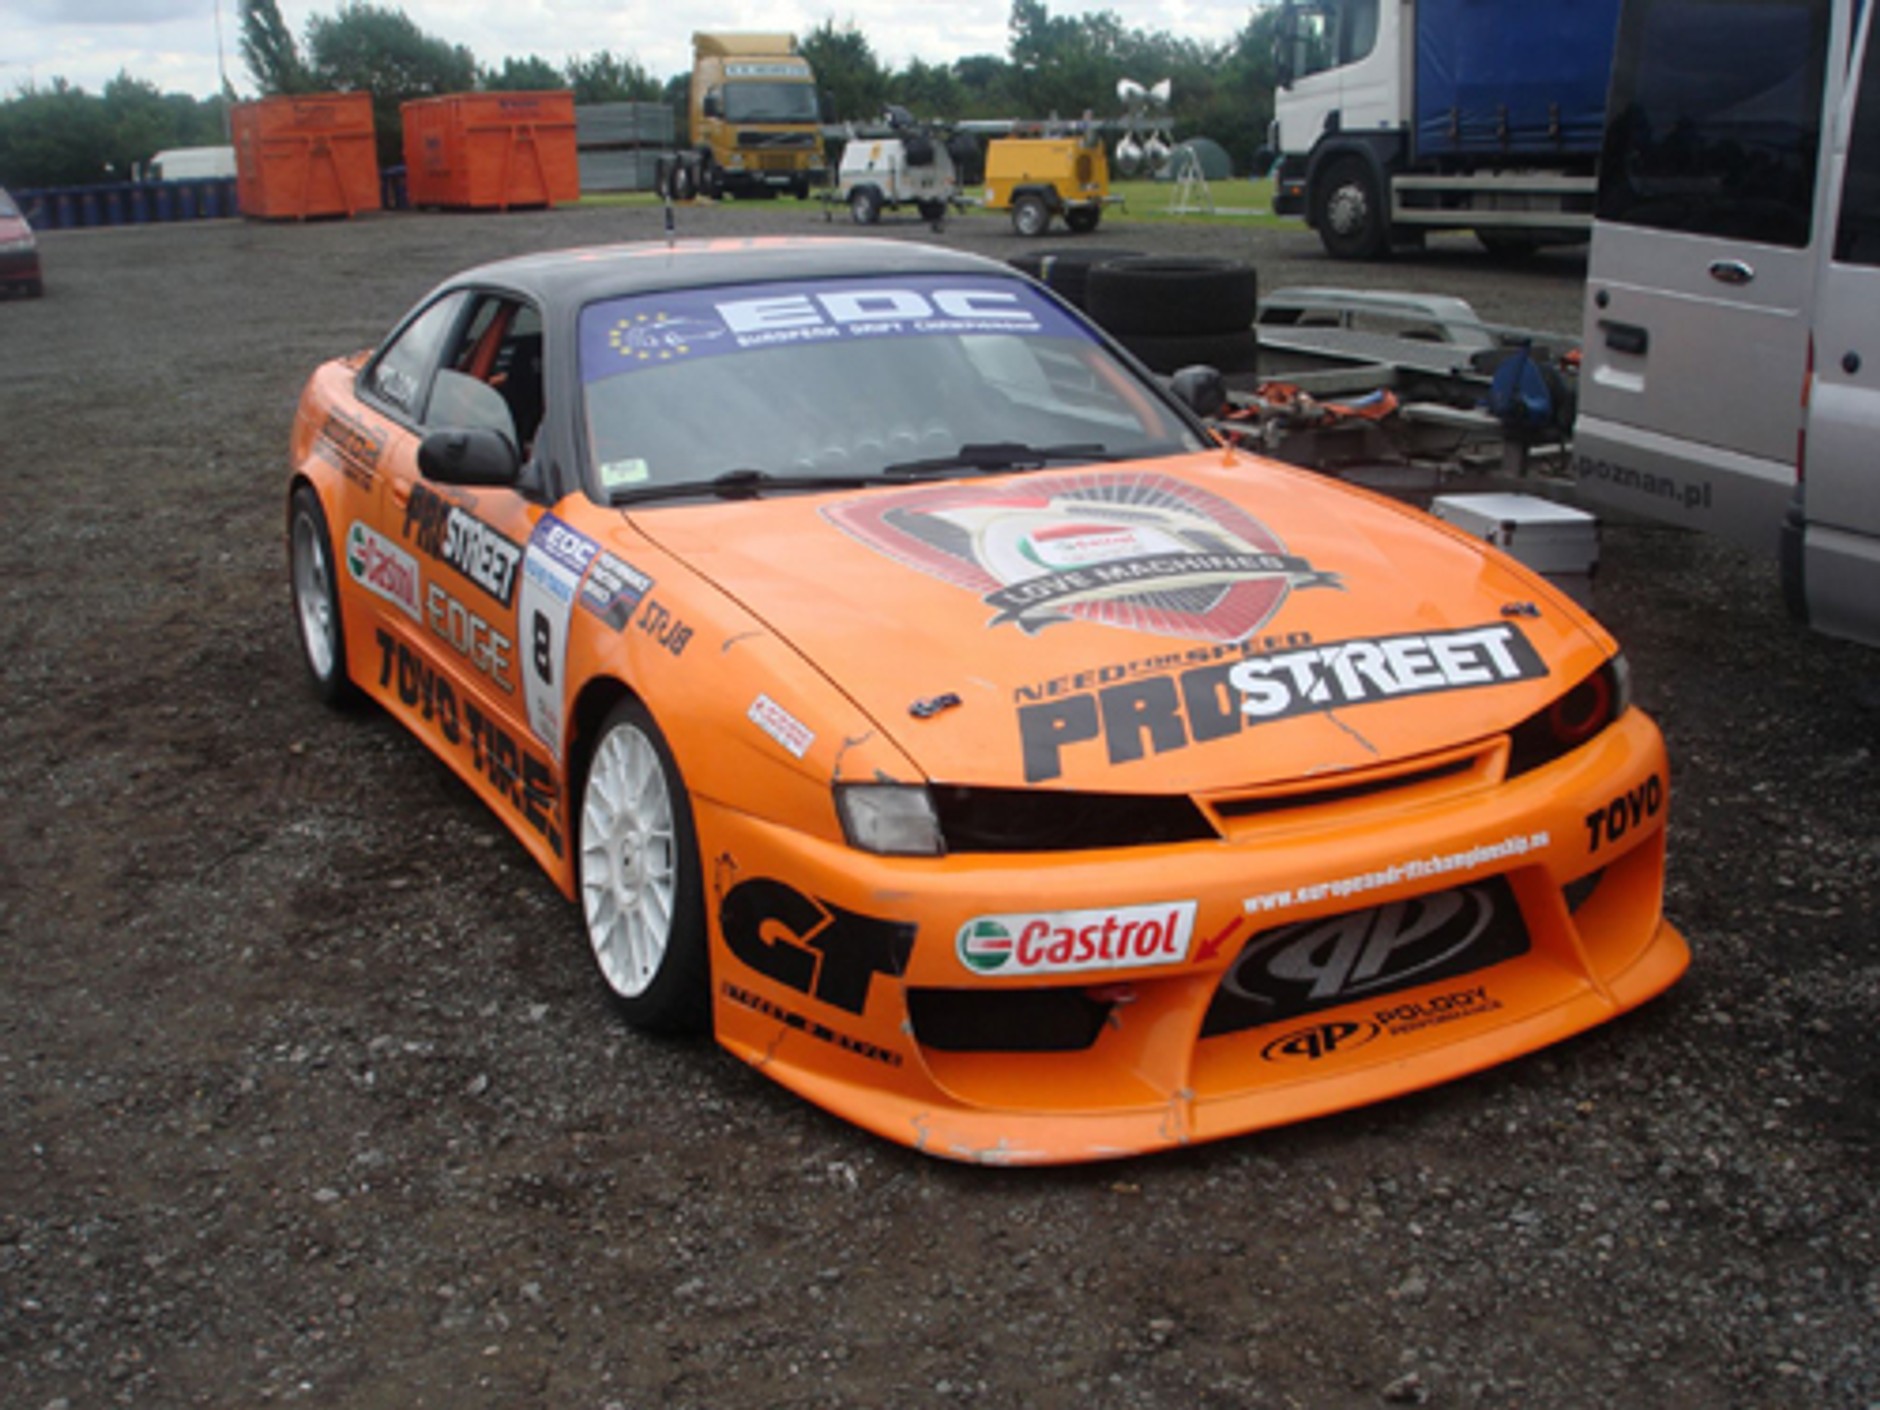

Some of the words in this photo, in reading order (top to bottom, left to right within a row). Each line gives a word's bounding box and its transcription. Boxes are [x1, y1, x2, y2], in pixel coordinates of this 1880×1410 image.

[714, 289, 1035, 334] EDC
[547, 525, 598, 566] EDC
[1004, 567, 1093, 603] LOVE
[1094, 555, 1286, 590] MACHINES
[427, 579, 516, 697] EDGE
[534, 608, 553, 686] 8
[1013, 664, 1127, 703] NEED
[1128, 653, 1182, 675] FOR
[1183, 631, 1316, 663] SPEED
[375, 627, 461, 746] TOYO
[1585, 772, 1663, 855] TOYO
[719, 875, 919, 1016] GT
[1015, 910, 1180, 968] Castrol
